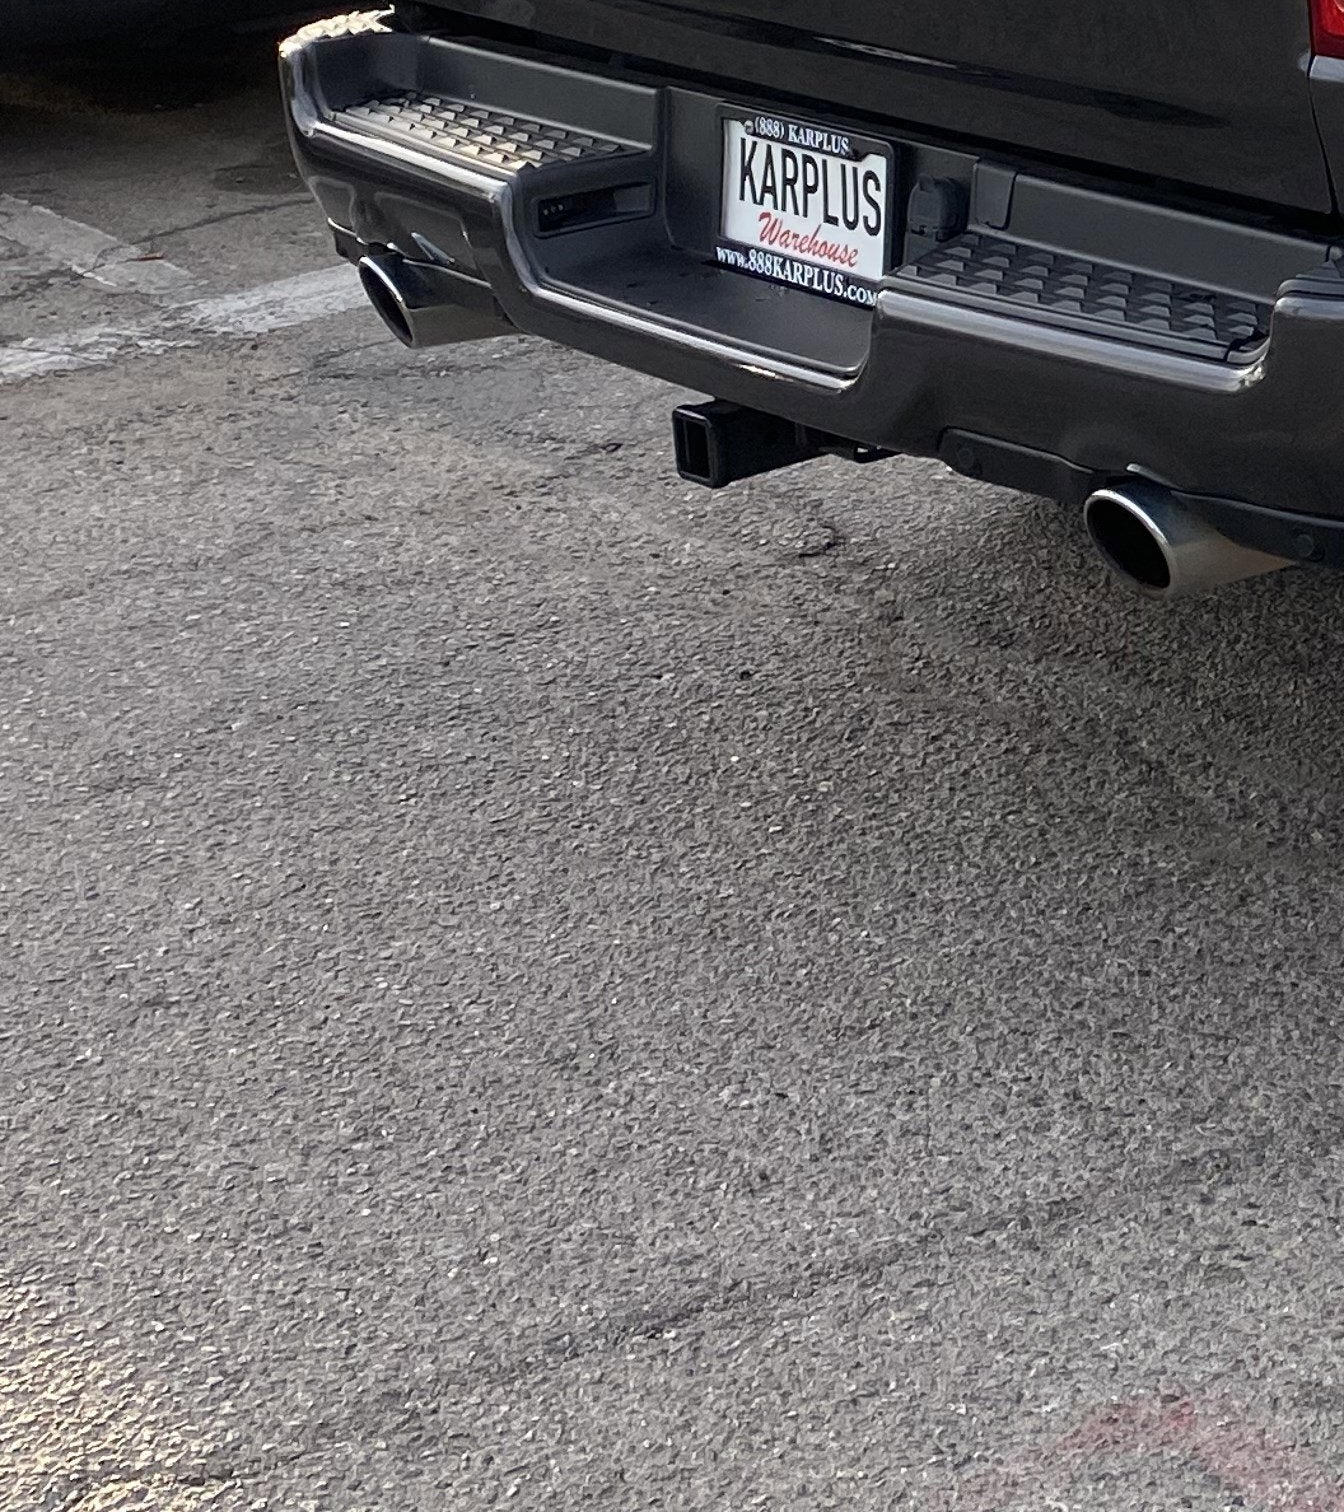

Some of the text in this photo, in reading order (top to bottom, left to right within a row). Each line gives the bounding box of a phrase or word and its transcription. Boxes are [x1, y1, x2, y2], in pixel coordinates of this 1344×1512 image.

[755, 116, 849, 154] (888) KARPLUS
[739, 137, 882, 236] KARPLUS
[758, 211, 859, 268] Warehouse
